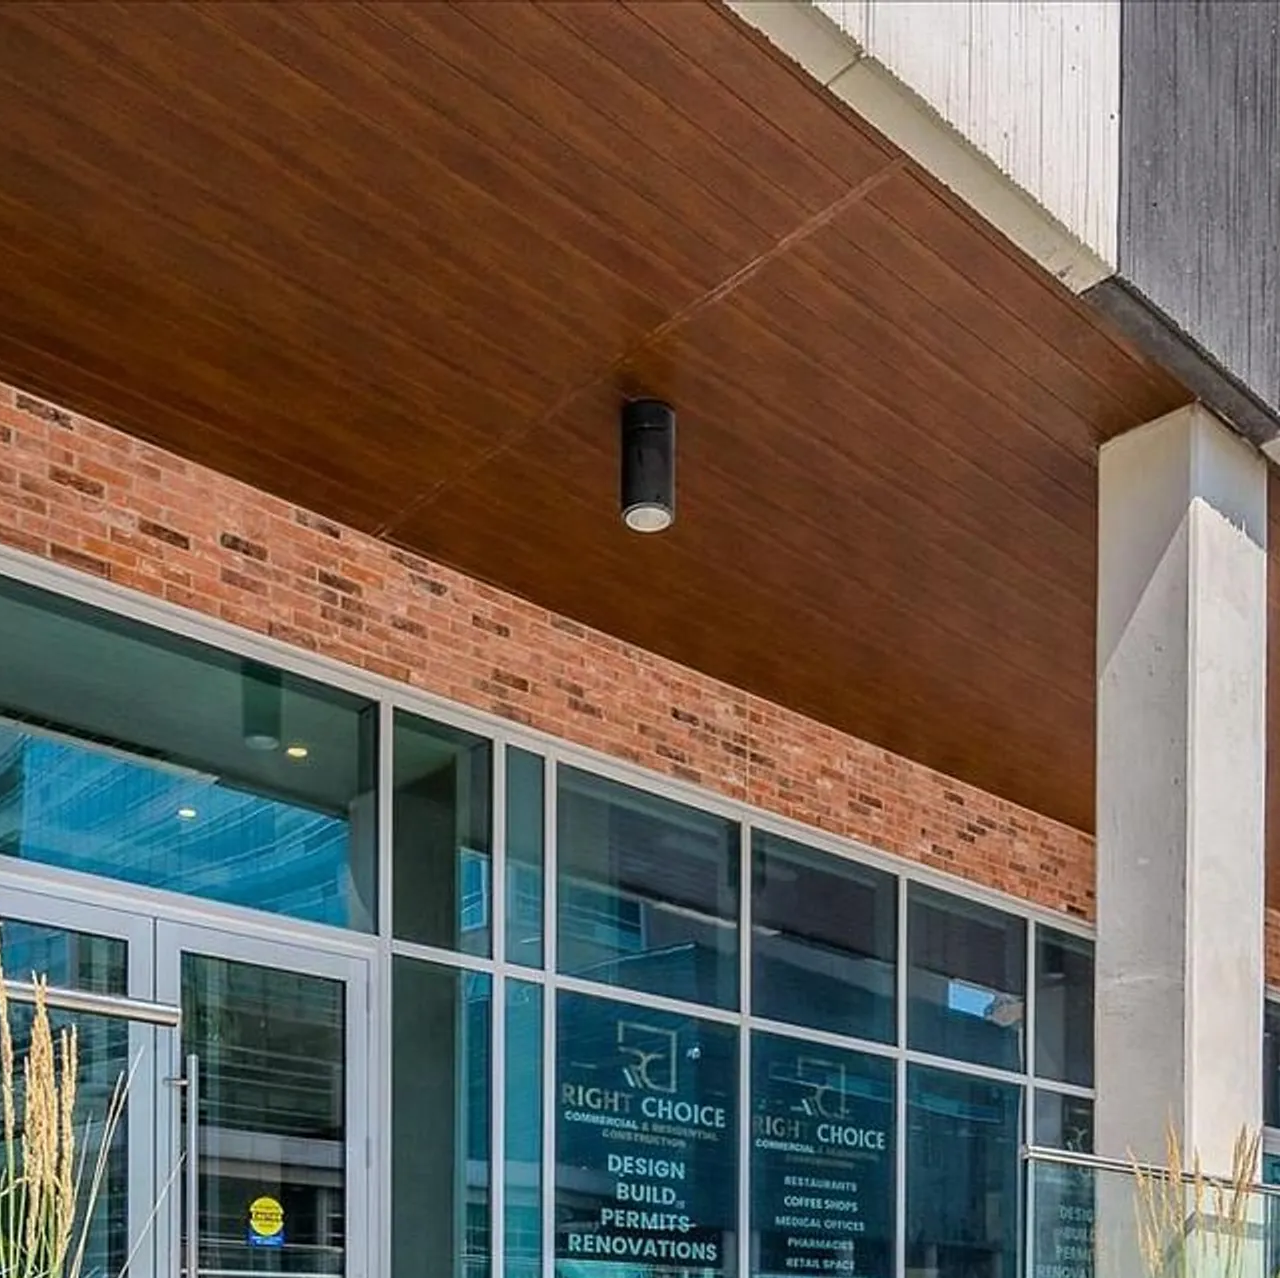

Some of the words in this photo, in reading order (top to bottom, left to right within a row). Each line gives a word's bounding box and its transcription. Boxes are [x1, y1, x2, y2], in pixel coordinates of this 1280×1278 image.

[562, 1083, 633, 1112] RIGHT
[642, 1097, 725, 1127] CHOICE
[564, 1110, 638, 1130] COMMERCIAL
[817, 1124, 886, 1150] CHOICE
[608, 1154, 685, 1180] DESIGN
[616, 1182, 676, 1206] BUILD
[784, 1195, 822, 1210] COFFEE
[601, 1208, 690, 1233] PERMITS
[568, 1233, 717, 1261] RENOVATIONS
